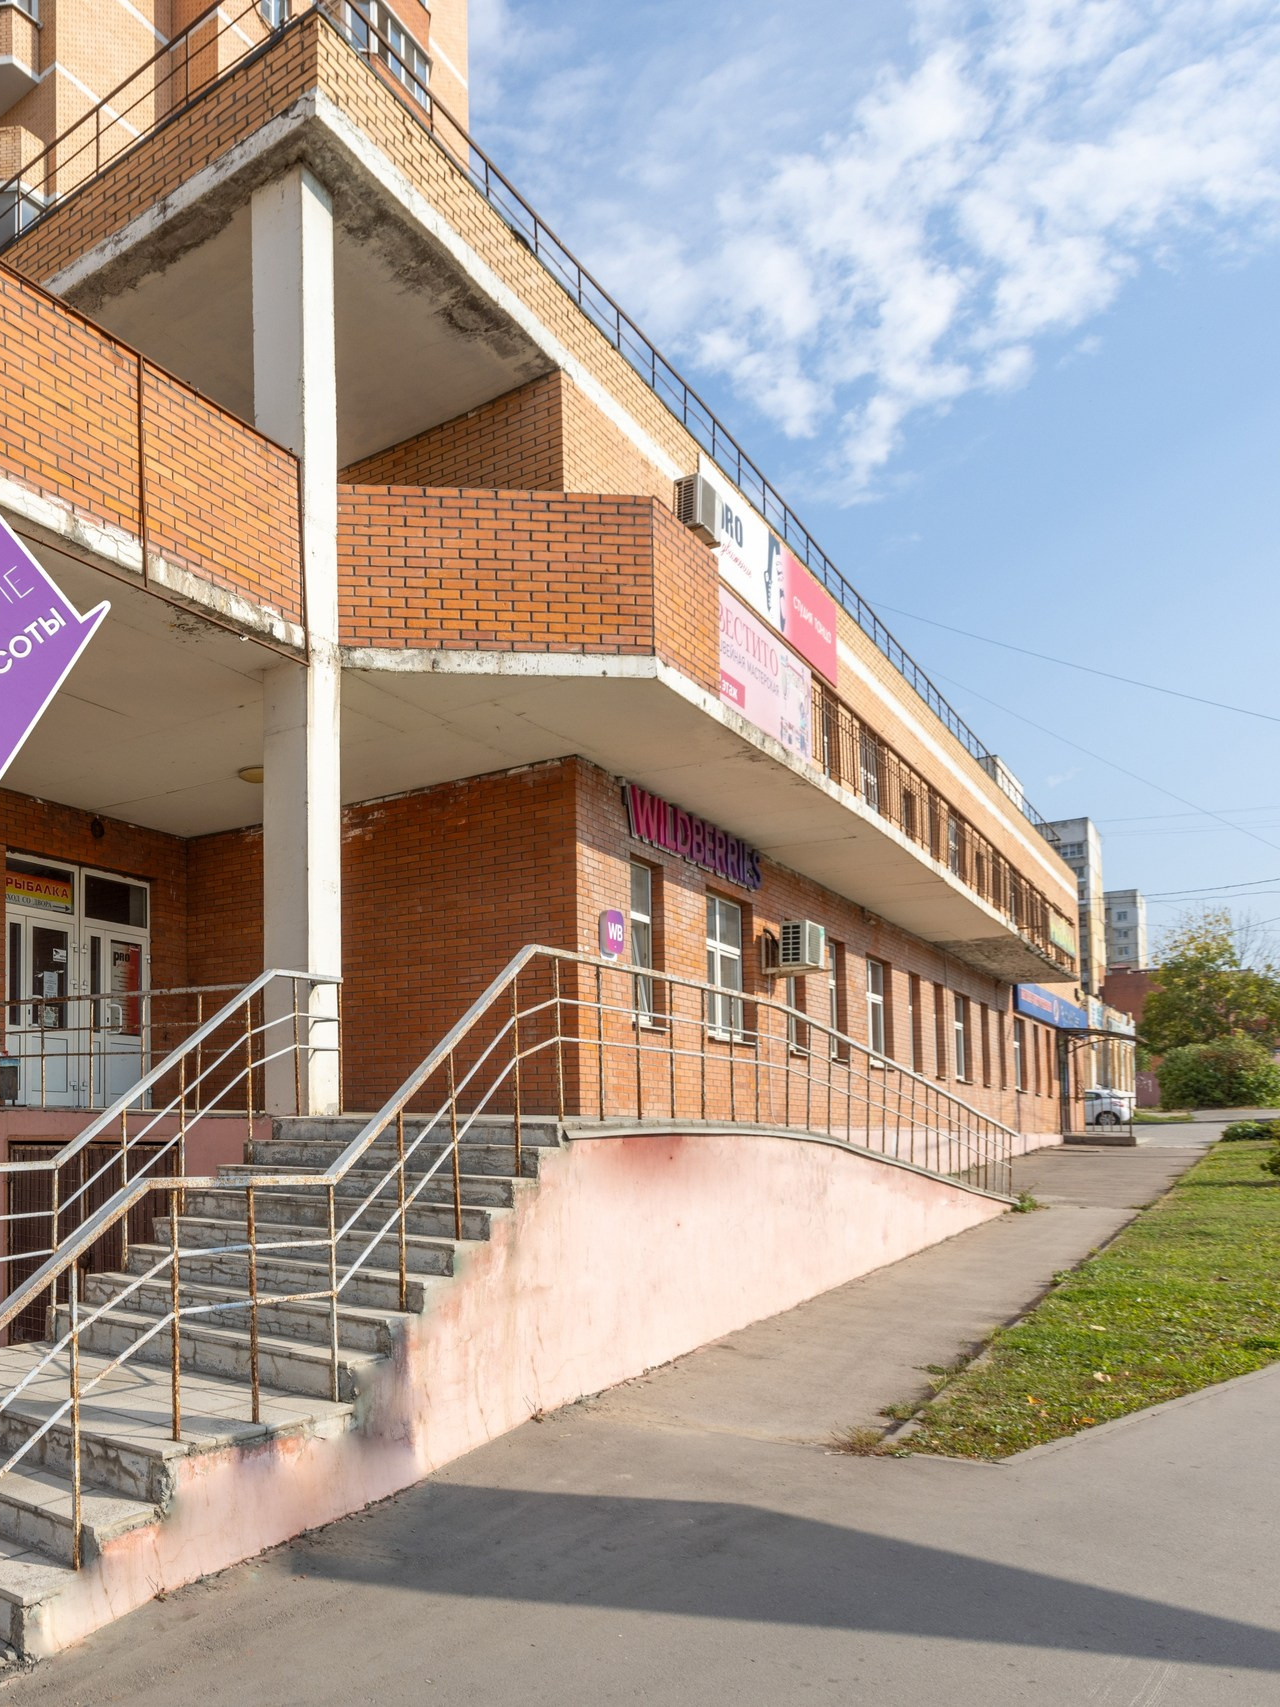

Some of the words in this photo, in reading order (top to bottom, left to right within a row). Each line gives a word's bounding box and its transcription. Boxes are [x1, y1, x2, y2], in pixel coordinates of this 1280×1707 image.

[720, 640, 746, 669] ВЕЙНАЯ
[630, 784, 763, 891] WILDBERRIES
[5, 877, 69, 899] РЫБАЛКА
[33, 898, 52, 908] ДВОРА
[607, 921, 623, 942] WB
